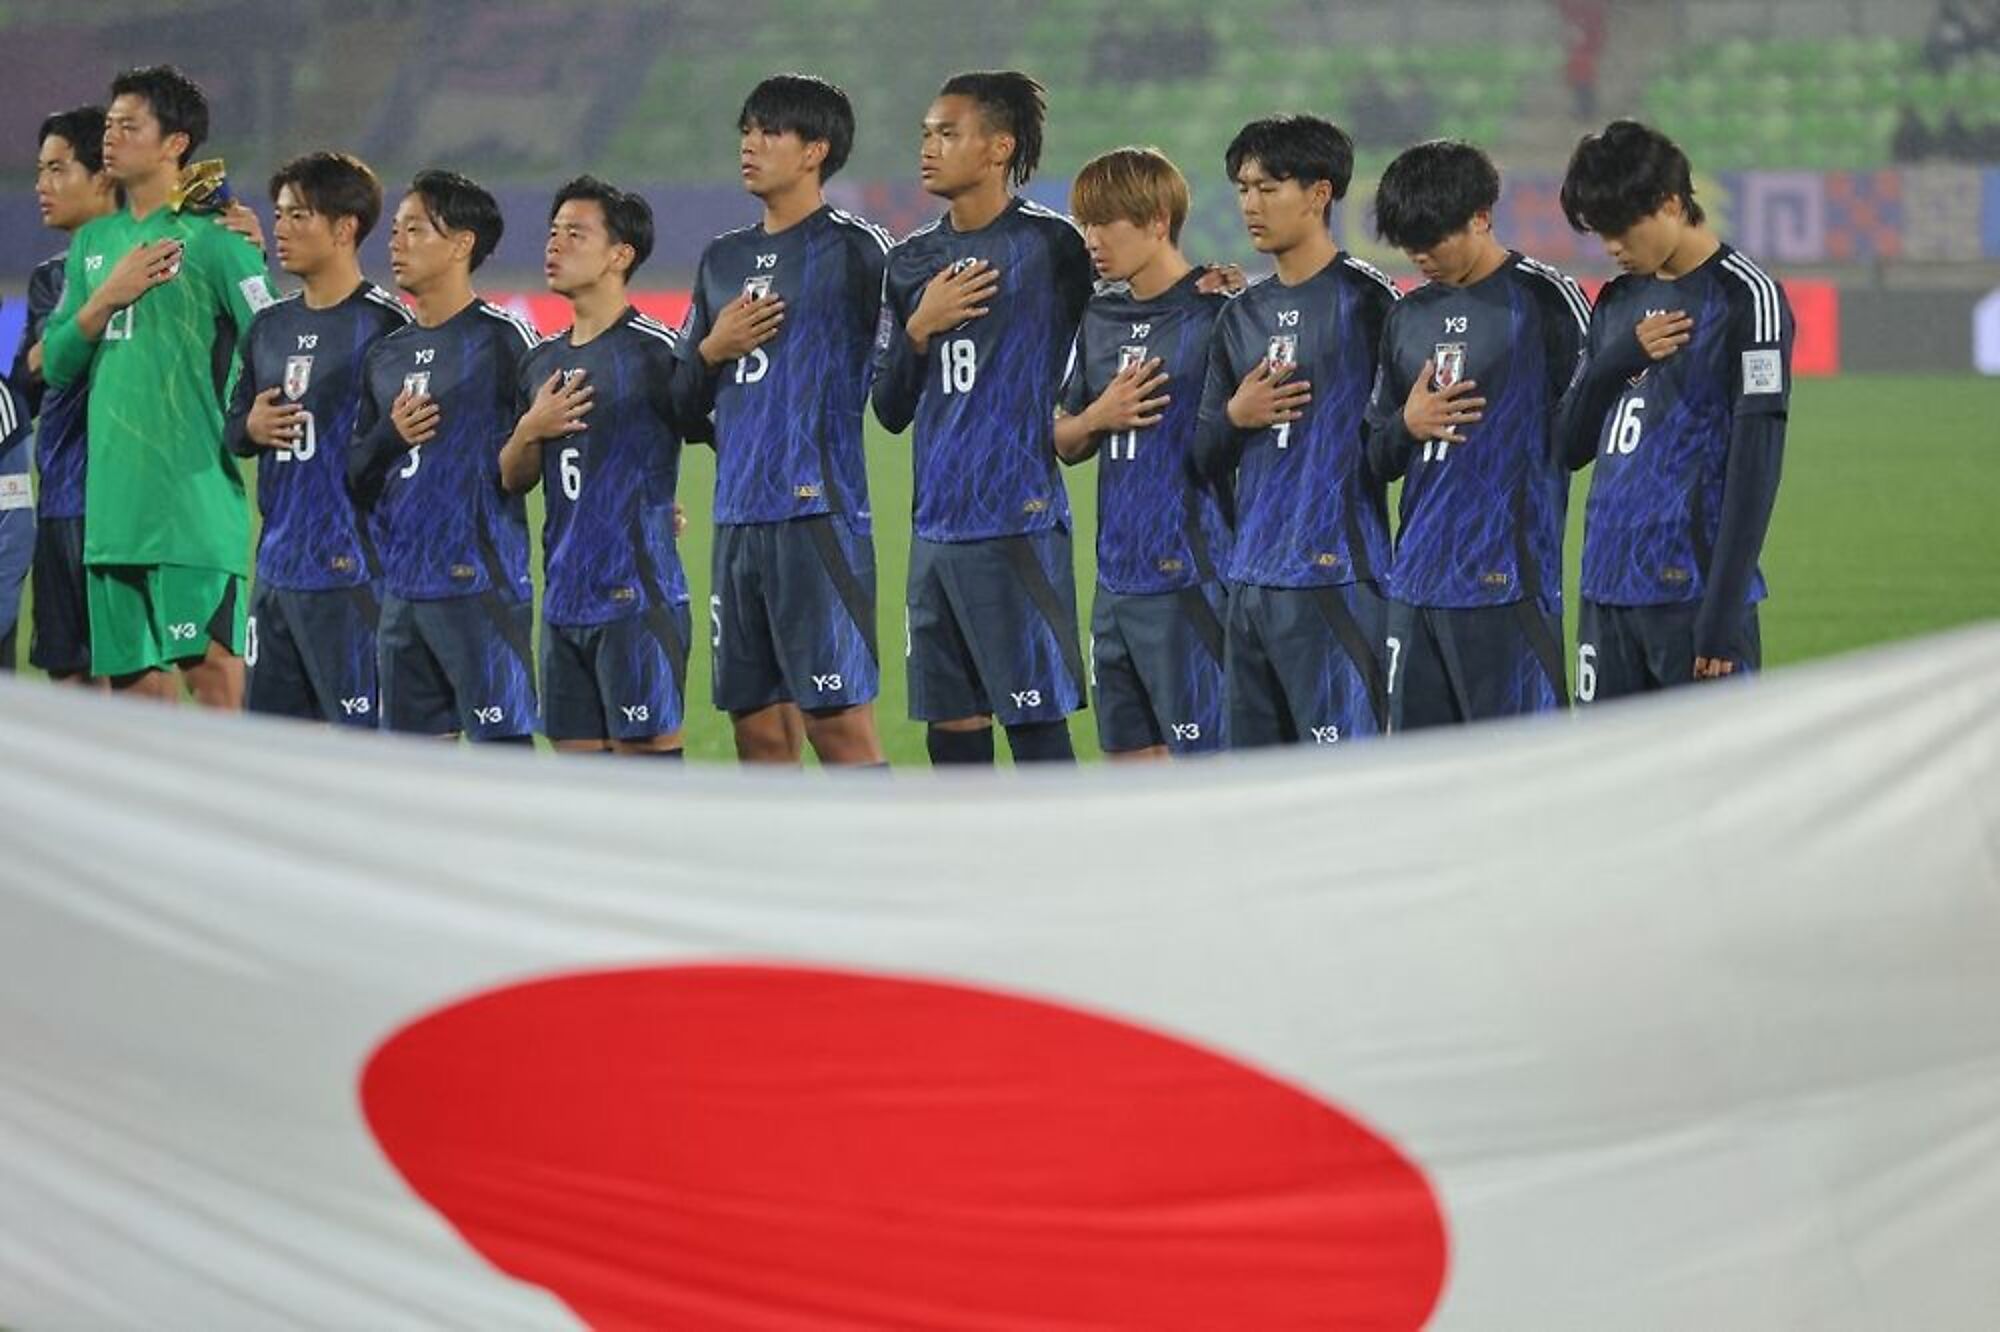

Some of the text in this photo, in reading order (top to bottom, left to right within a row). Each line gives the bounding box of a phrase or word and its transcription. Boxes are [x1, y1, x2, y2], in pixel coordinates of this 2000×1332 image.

[1277, 310, 1299, 328] Y-3
[1445, 317, 1467, 334] Y-3
[941, 339, 975, 394] 18
[1606, 397, 1645, 455] 16
[560, 448, 581, 501] 6
[168, 621, 196, 640] Y-3
[812, 674, 842, 691] Y-3
[341, 696, 370, 714] Y-3
[1010, 690, 1041, 709] Y-3
[474, 706, 503, 725] Y-3
[621, 705, 649, 722] Y-3
[1171, 723, 1200, 741] Y-3
[1311, 725, 1339, 744] Y-3
